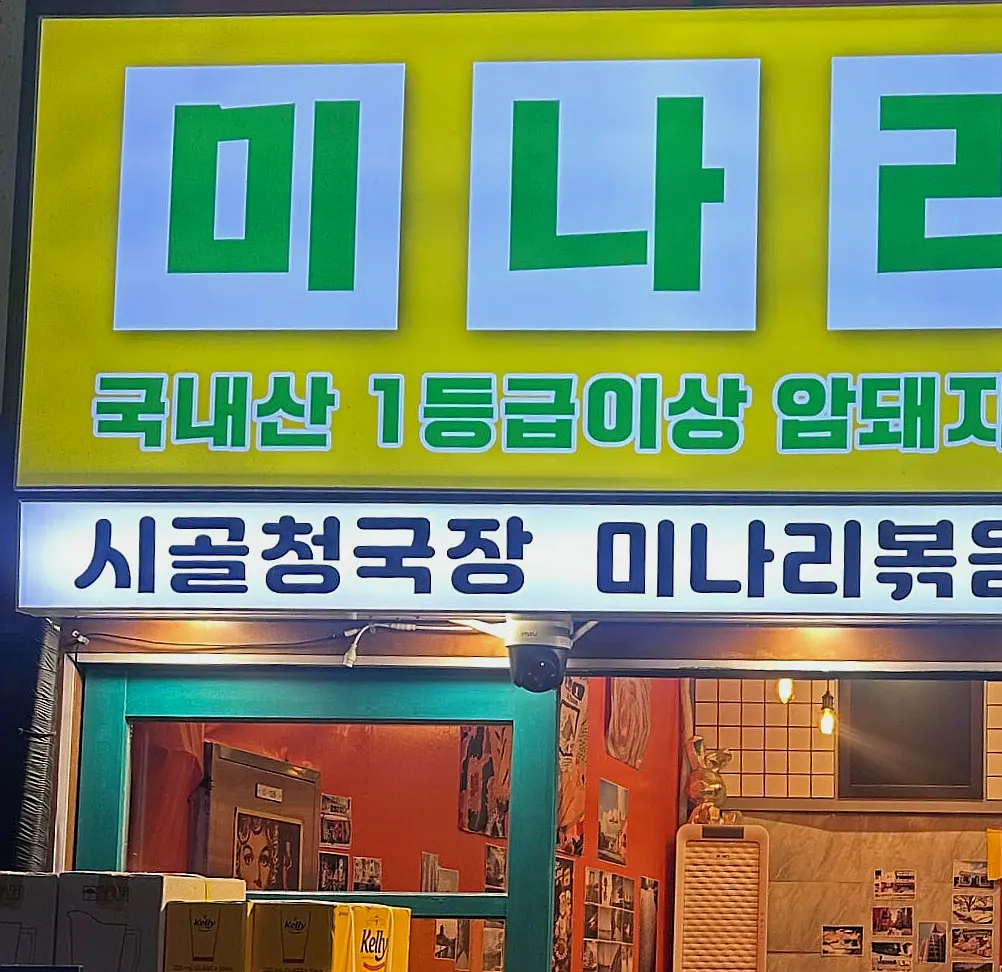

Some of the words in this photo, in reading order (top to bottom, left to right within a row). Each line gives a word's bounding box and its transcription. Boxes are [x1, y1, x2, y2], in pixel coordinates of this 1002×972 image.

[92, 371, 339, 452] 국내산
[368, 371, 752, 455] 1등급이상
[73, 514, 533, 596] 시골청국장
[193, 918, 217, 930] Kelly
[284, 920, 307, 931] Kelly
[360, 929, 388, 962] Kelly
